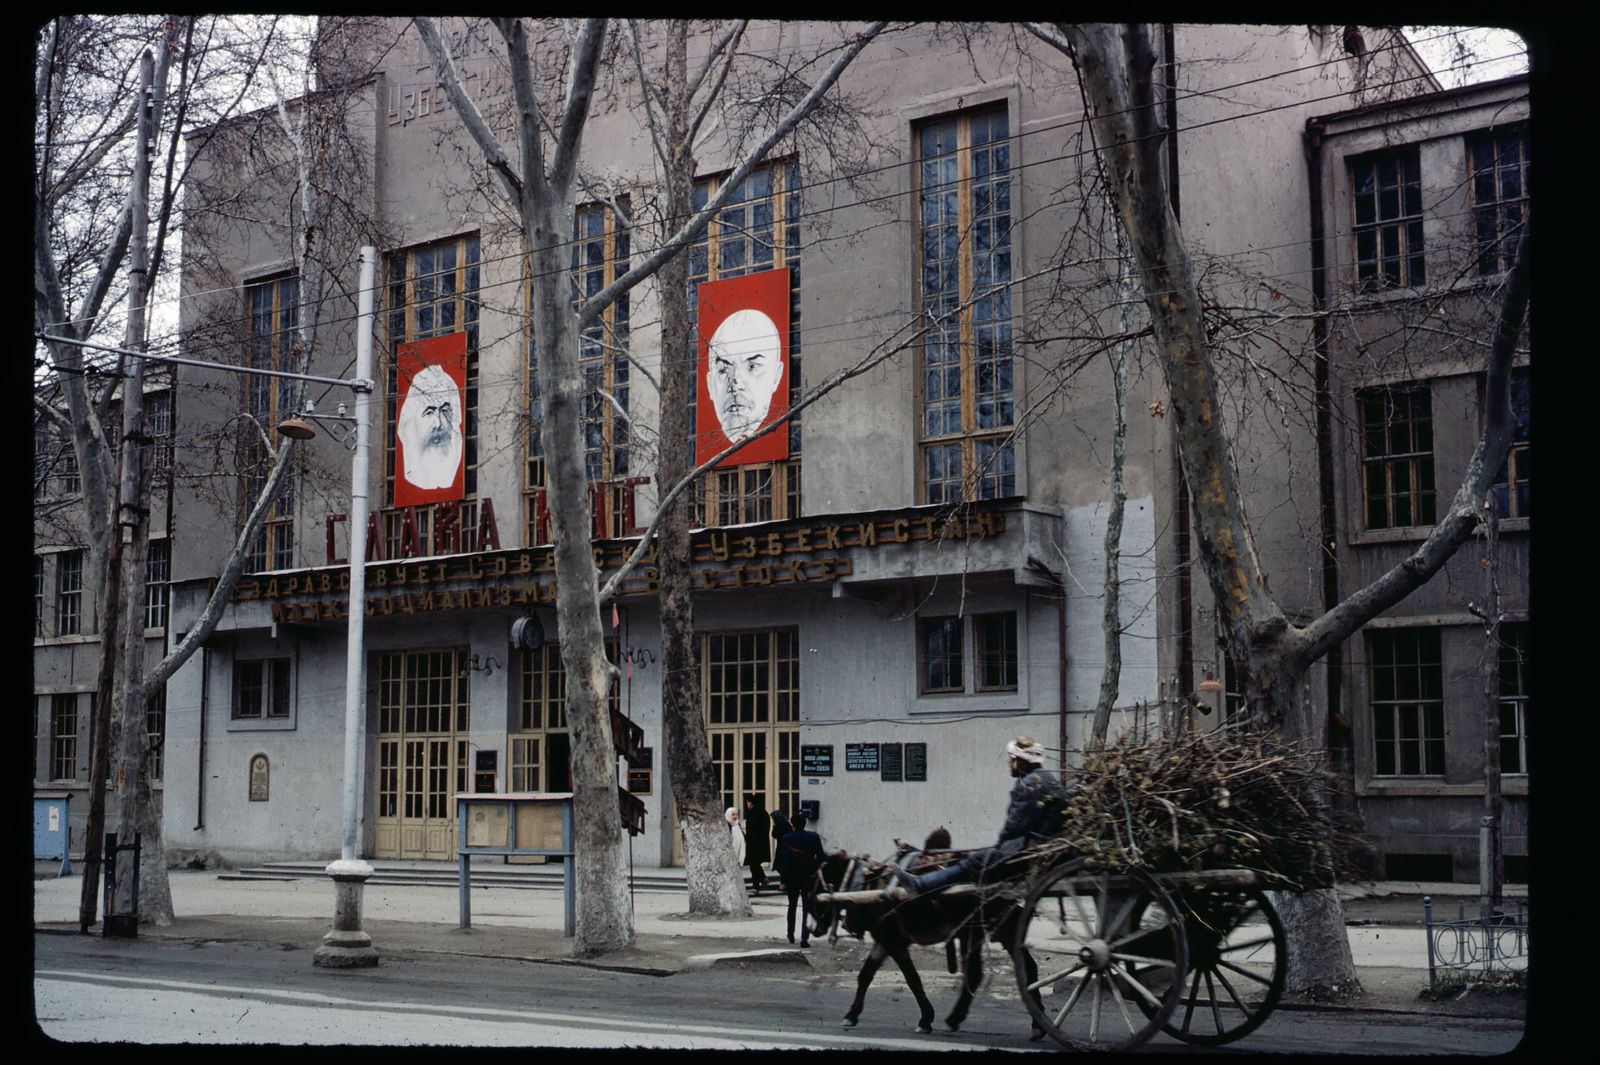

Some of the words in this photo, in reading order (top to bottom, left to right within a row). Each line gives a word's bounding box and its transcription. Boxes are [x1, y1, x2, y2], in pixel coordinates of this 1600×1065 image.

[252, 563, 447, 600] ЗДРАВСВУЕТ
[711, 512, 995, 561] УЗБЕКИСТАН
[326, 498, 501, 564] СЛАВА
[271, 600, 339, 622] МАЯК
[644, 557, 837, 596] ВСТОКЕ
